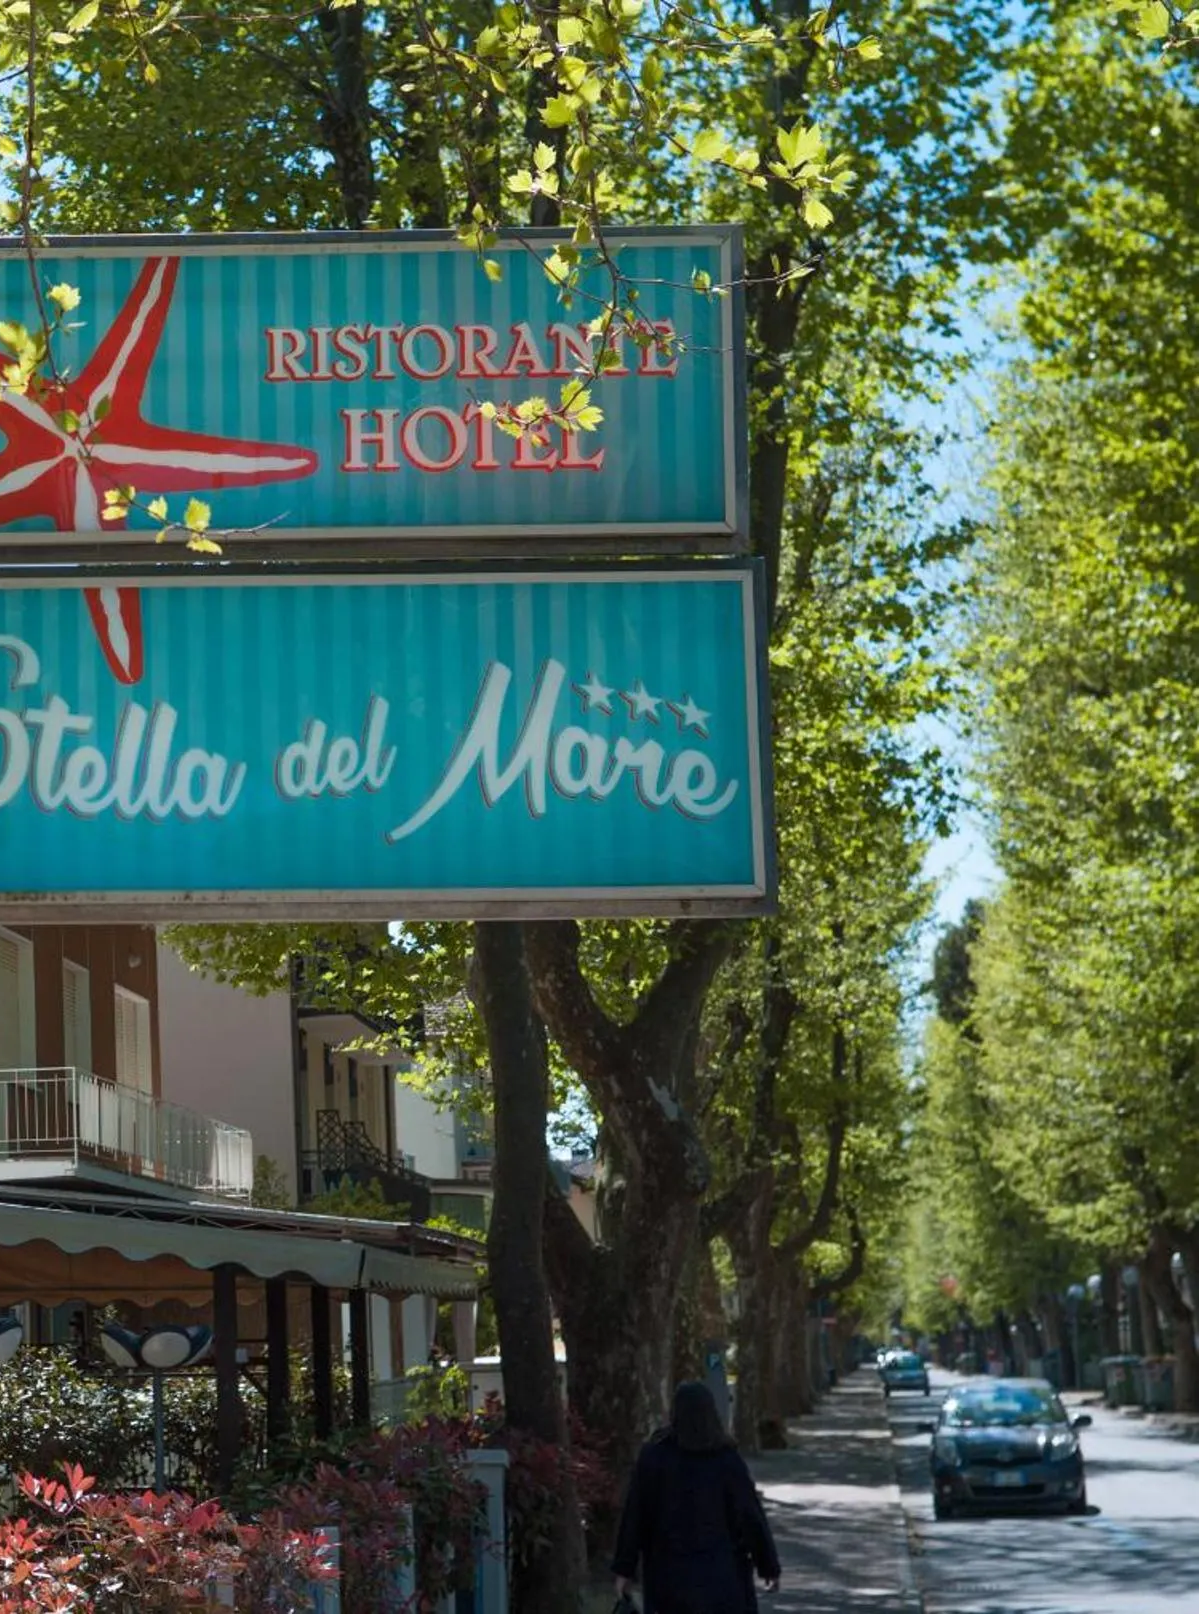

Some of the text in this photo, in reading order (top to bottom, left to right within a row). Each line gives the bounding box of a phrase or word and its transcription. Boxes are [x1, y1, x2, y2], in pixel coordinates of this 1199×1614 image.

[264, 319, 679, 381] RISTORANTE
[340, 402, 604, 473] HOTEL
[274, 689, 397, 800] del
[384, 658, 738, 845] Mare
